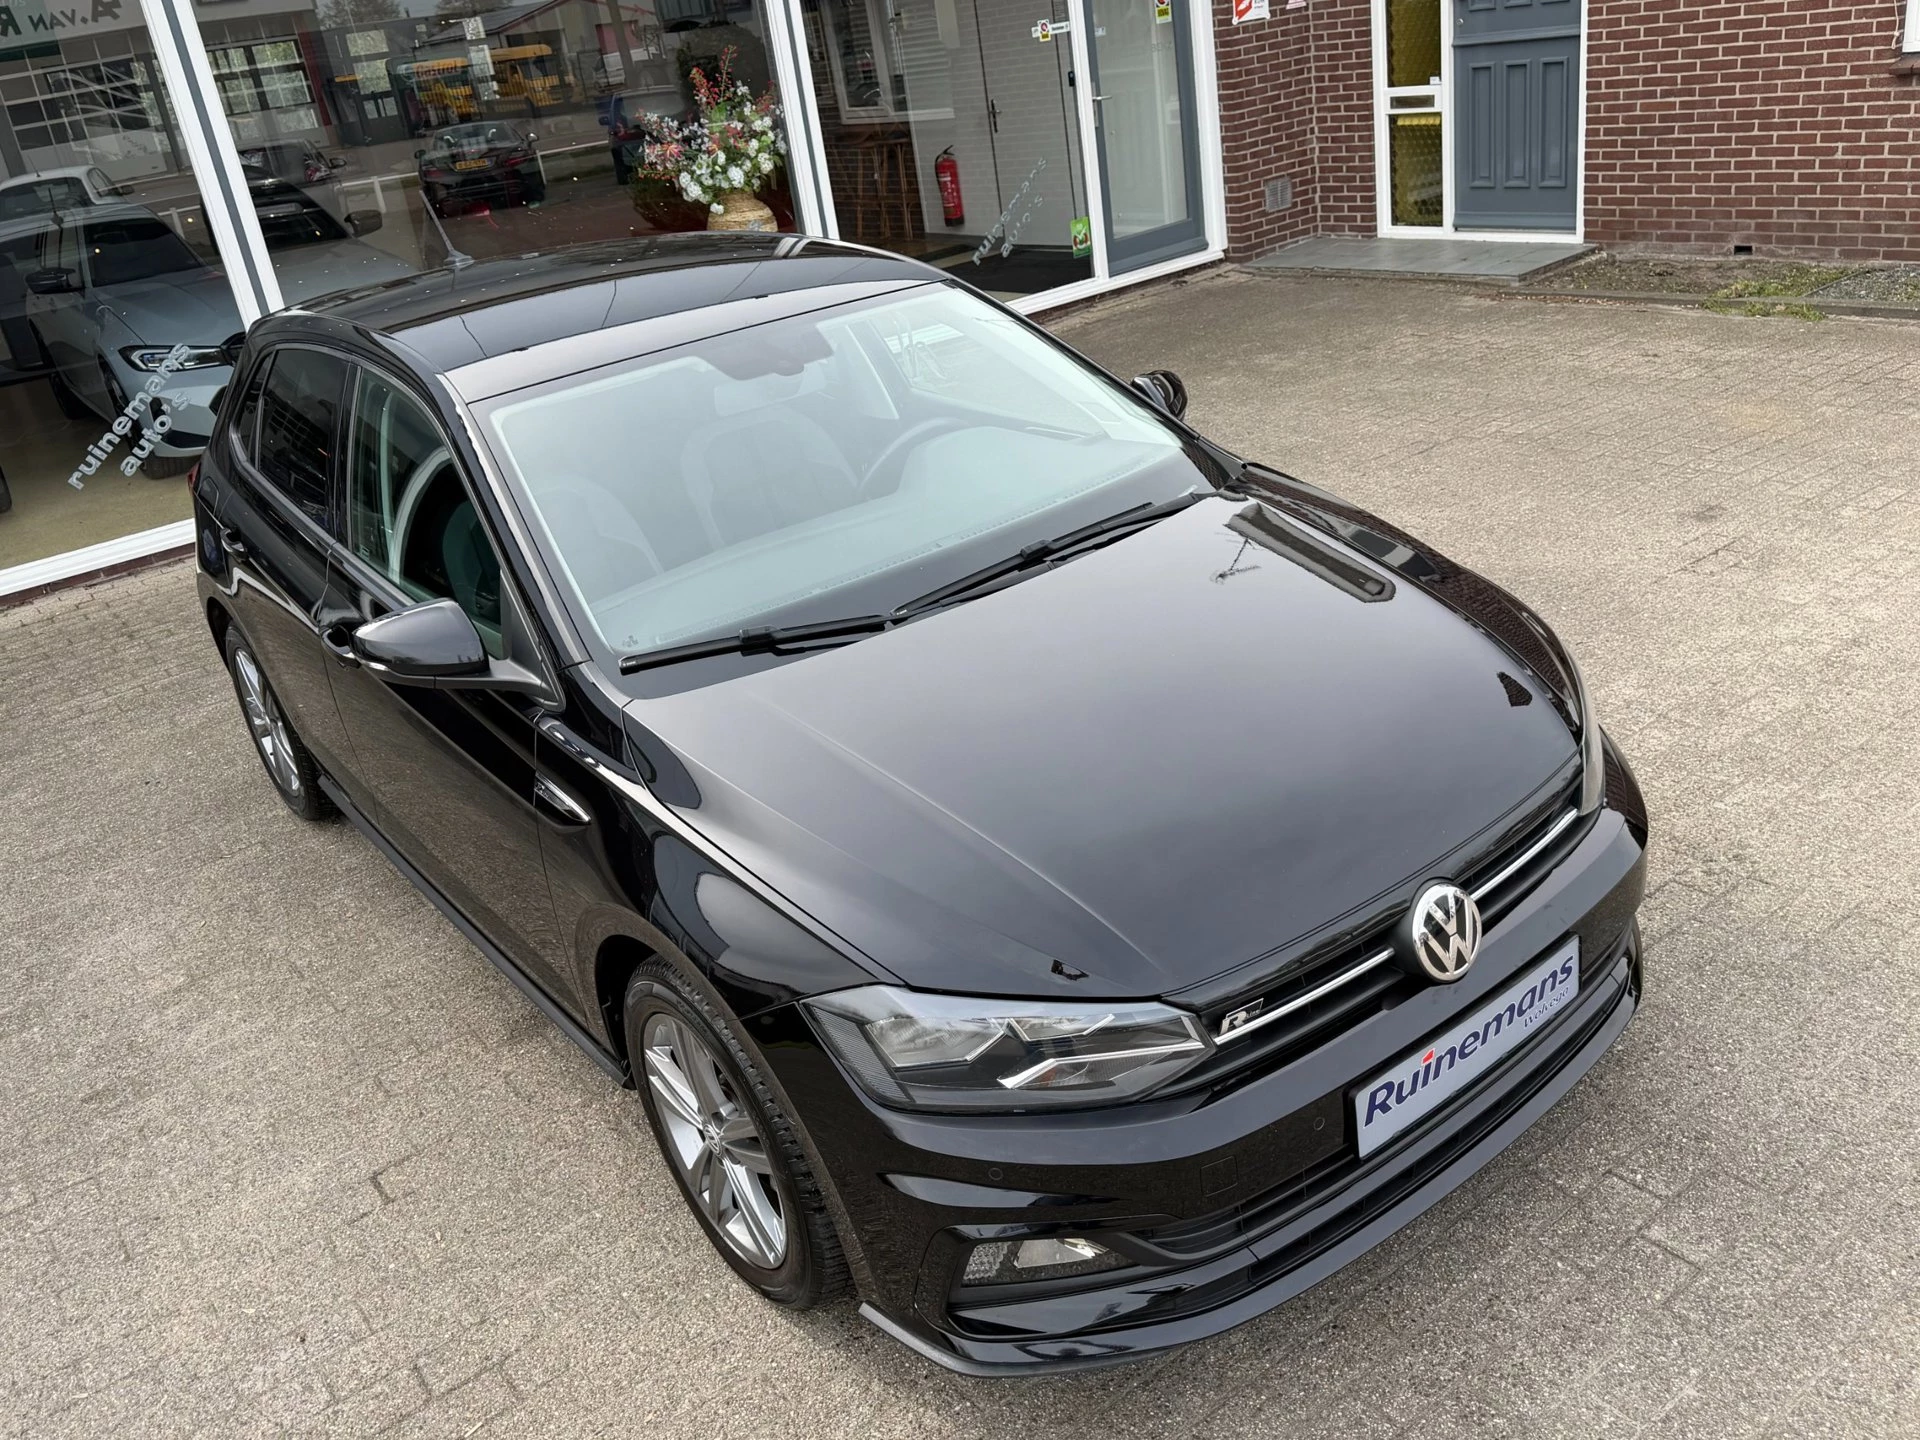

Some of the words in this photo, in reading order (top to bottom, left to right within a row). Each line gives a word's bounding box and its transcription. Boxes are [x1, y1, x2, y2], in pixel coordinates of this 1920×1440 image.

[68, 343, 190, 490] ruinemans
[120, 392, 190, 477] auto's
[1364, 955, 1574, 1128] Ruinemans
